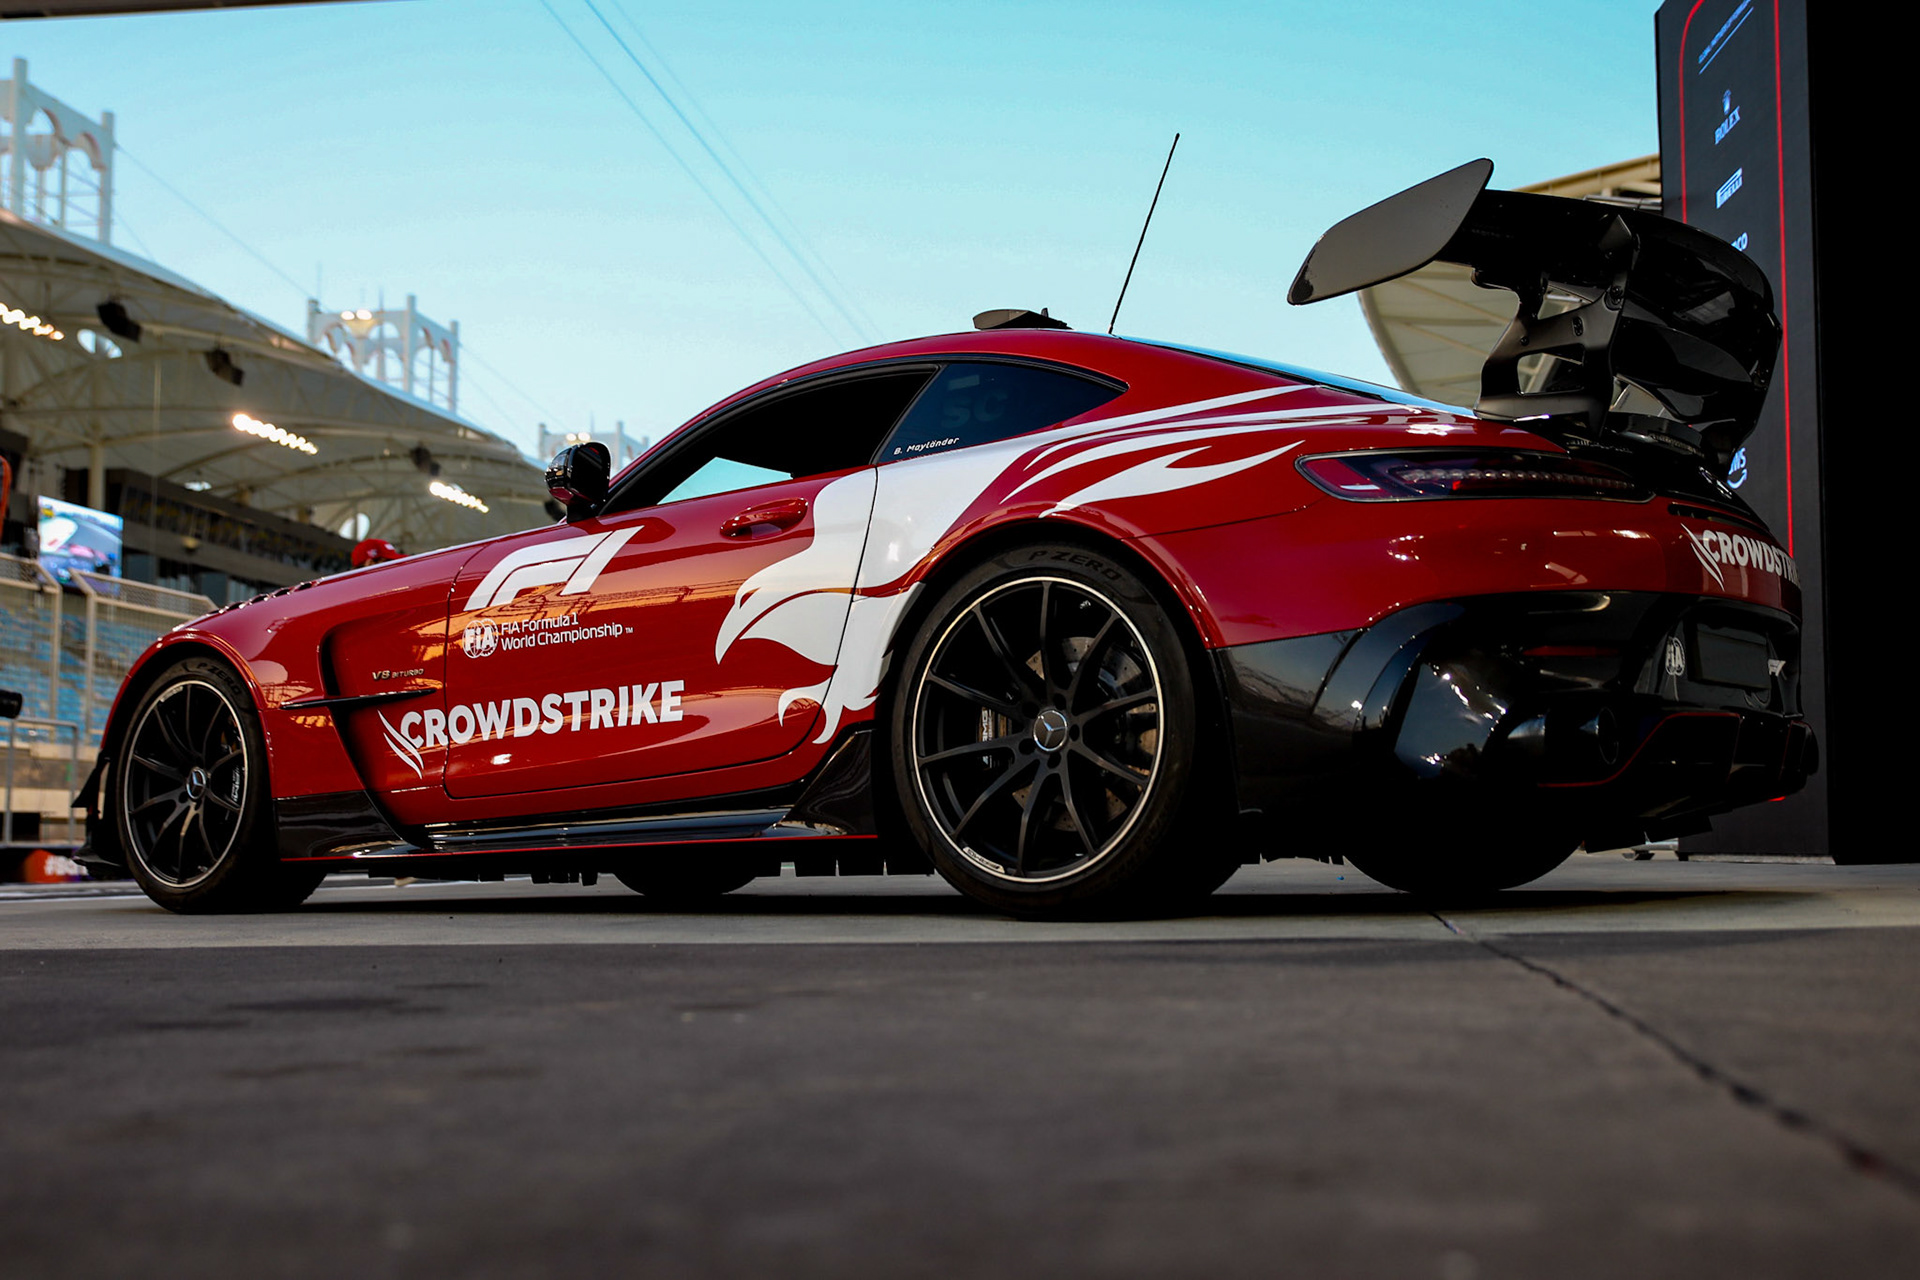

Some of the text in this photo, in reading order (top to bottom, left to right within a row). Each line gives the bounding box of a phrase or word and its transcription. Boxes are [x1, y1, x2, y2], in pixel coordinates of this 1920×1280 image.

[1715, 105, 1740, 145] ROLEX
[893, 437, 960, 455] B. Mayländer
[463, 525, 645, 611] F1
[1028, 550, 1122, 580] P ZERO
[501, 612, 579, 636] FIA Formula 1
[501, 634, 536, 651] World
[537, 622, 623, 646] Championship
[196, 662, 242, 696] P ZERO
[372, 670, 390, 680] V8
[400, 679, 686, 749] CROWDSTRIKE
